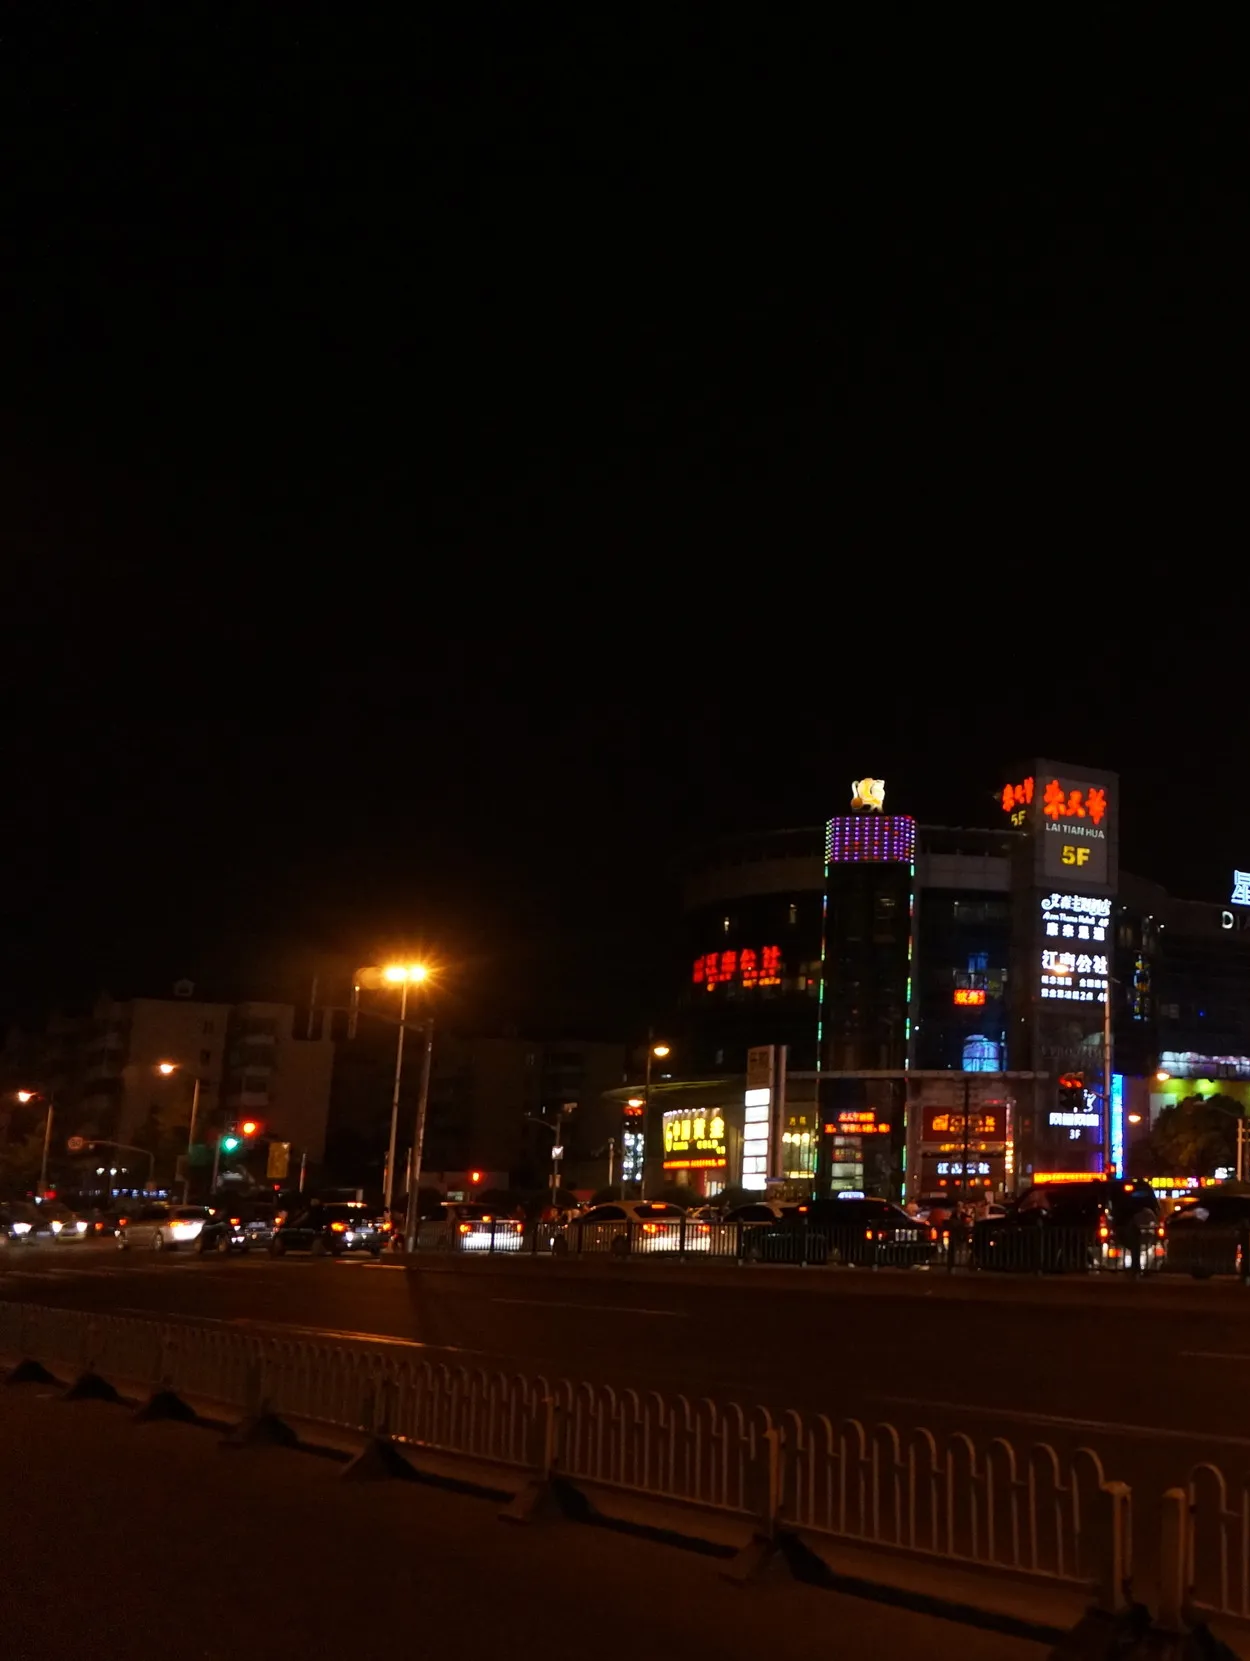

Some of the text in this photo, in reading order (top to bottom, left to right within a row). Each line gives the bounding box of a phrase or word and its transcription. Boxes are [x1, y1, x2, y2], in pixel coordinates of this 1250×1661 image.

[1011, 810, 1026, 826] 5F
[1045, 822, 1105, 839] LAI TIAN HUA
[1061, 845, 1091, 866] 5F
[673, 1116, 725, 1142] 中国黄金
